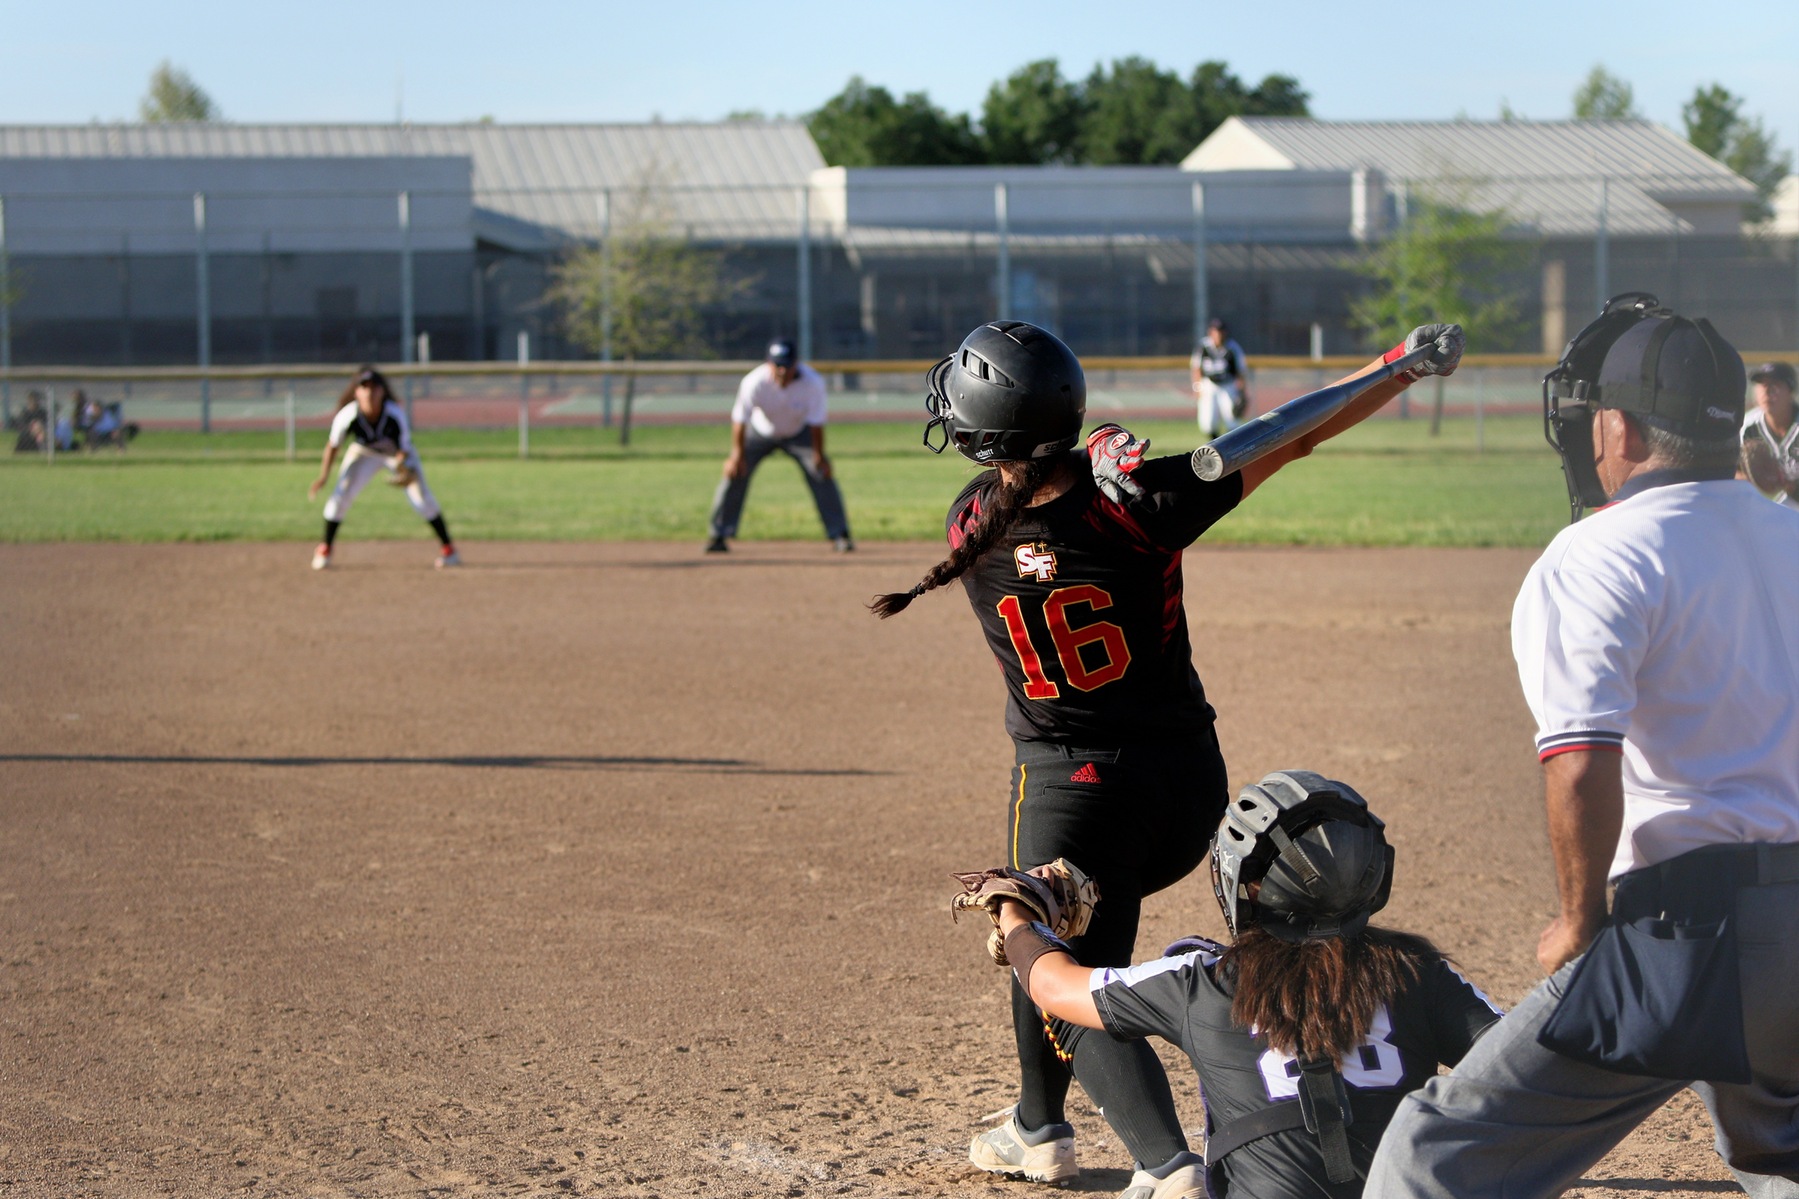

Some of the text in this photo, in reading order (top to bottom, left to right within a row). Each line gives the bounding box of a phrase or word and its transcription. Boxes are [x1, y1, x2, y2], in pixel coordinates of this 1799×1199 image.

[1014, 542, 1058, 582] SF
[996, 584, 1132, 700] 16
[1070, 774, 1102, 784] adidas
